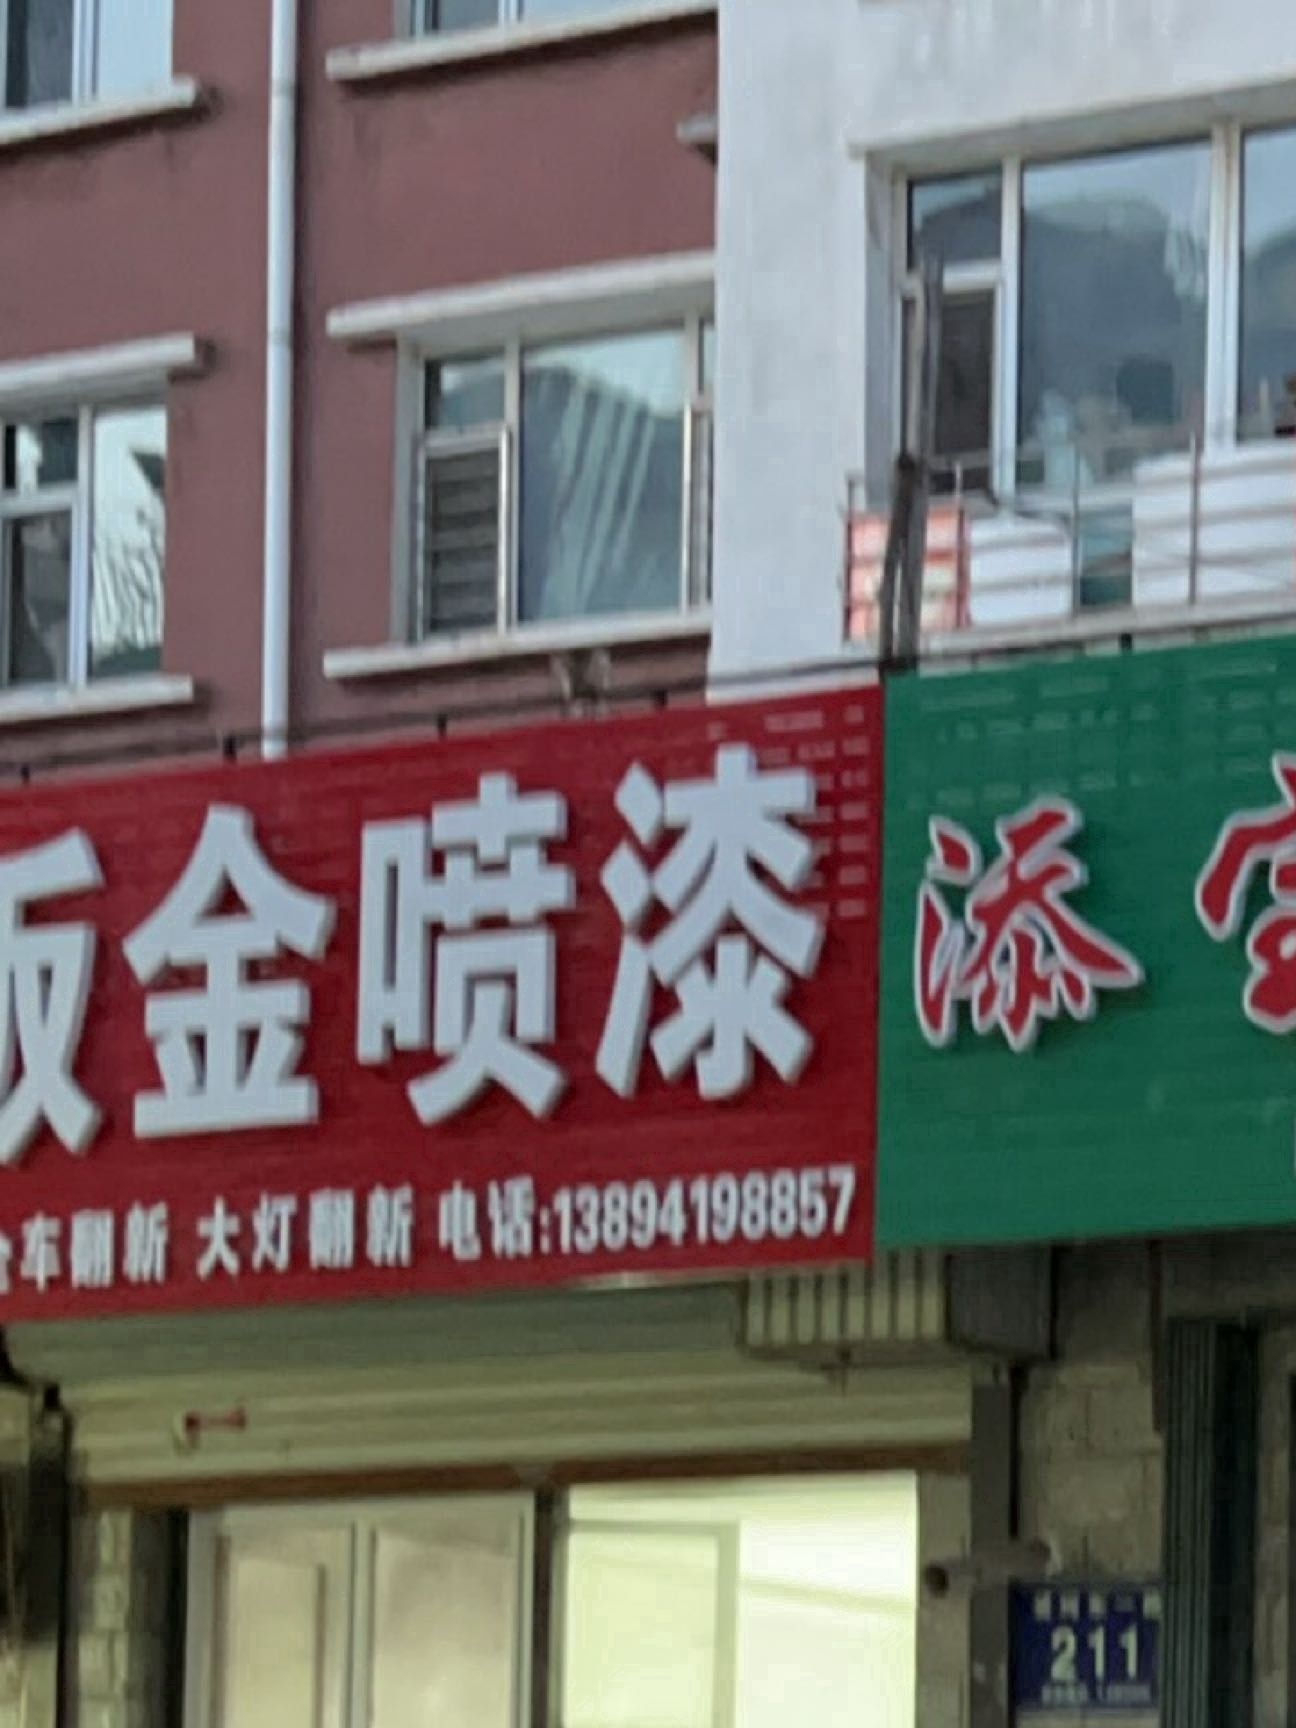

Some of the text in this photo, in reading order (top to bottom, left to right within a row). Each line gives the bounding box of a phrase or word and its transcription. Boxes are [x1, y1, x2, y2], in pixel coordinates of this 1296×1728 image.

[0, 1200, 169, 1294] 车翻新
[1051, 1623, 1138, 1681] 211
